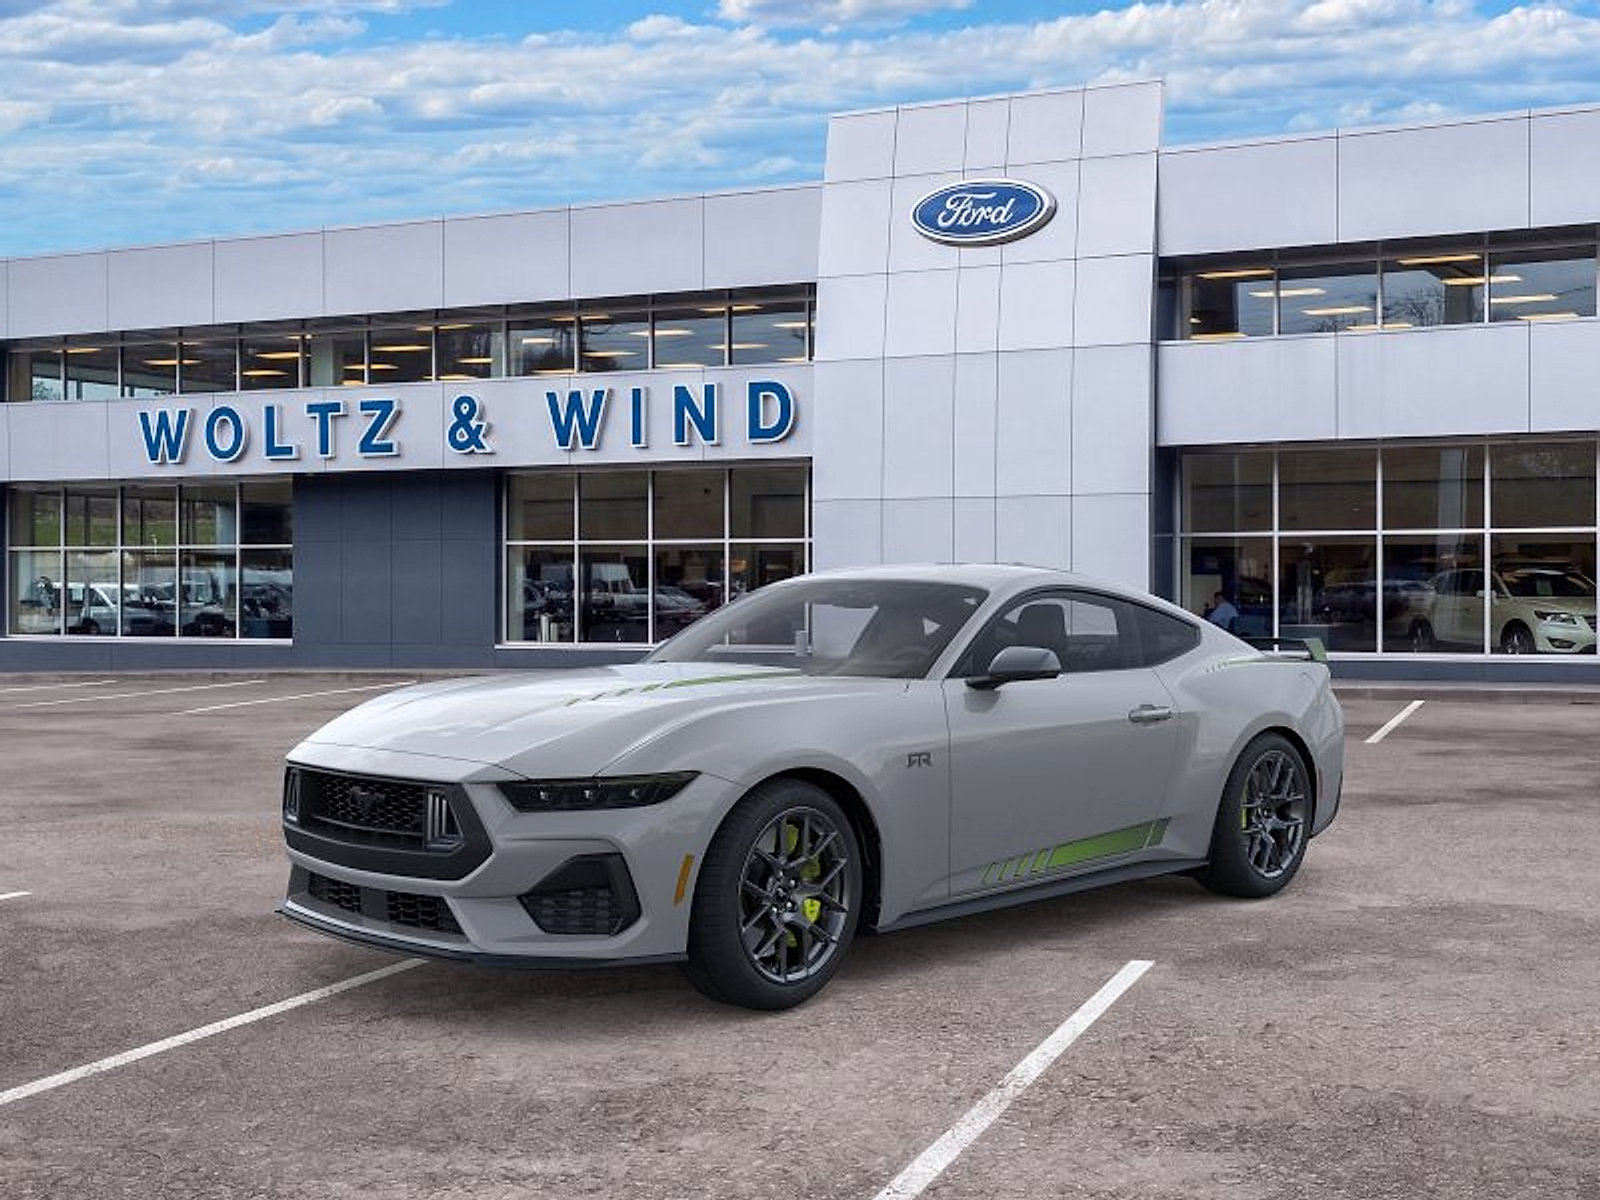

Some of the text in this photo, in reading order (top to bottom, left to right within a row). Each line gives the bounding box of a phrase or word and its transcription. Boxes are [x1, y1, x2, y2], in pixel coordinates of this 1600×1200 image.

[937, 191, 1015, 228] Ford
[139, 380, 796, 464] WOLTZ & WIND
